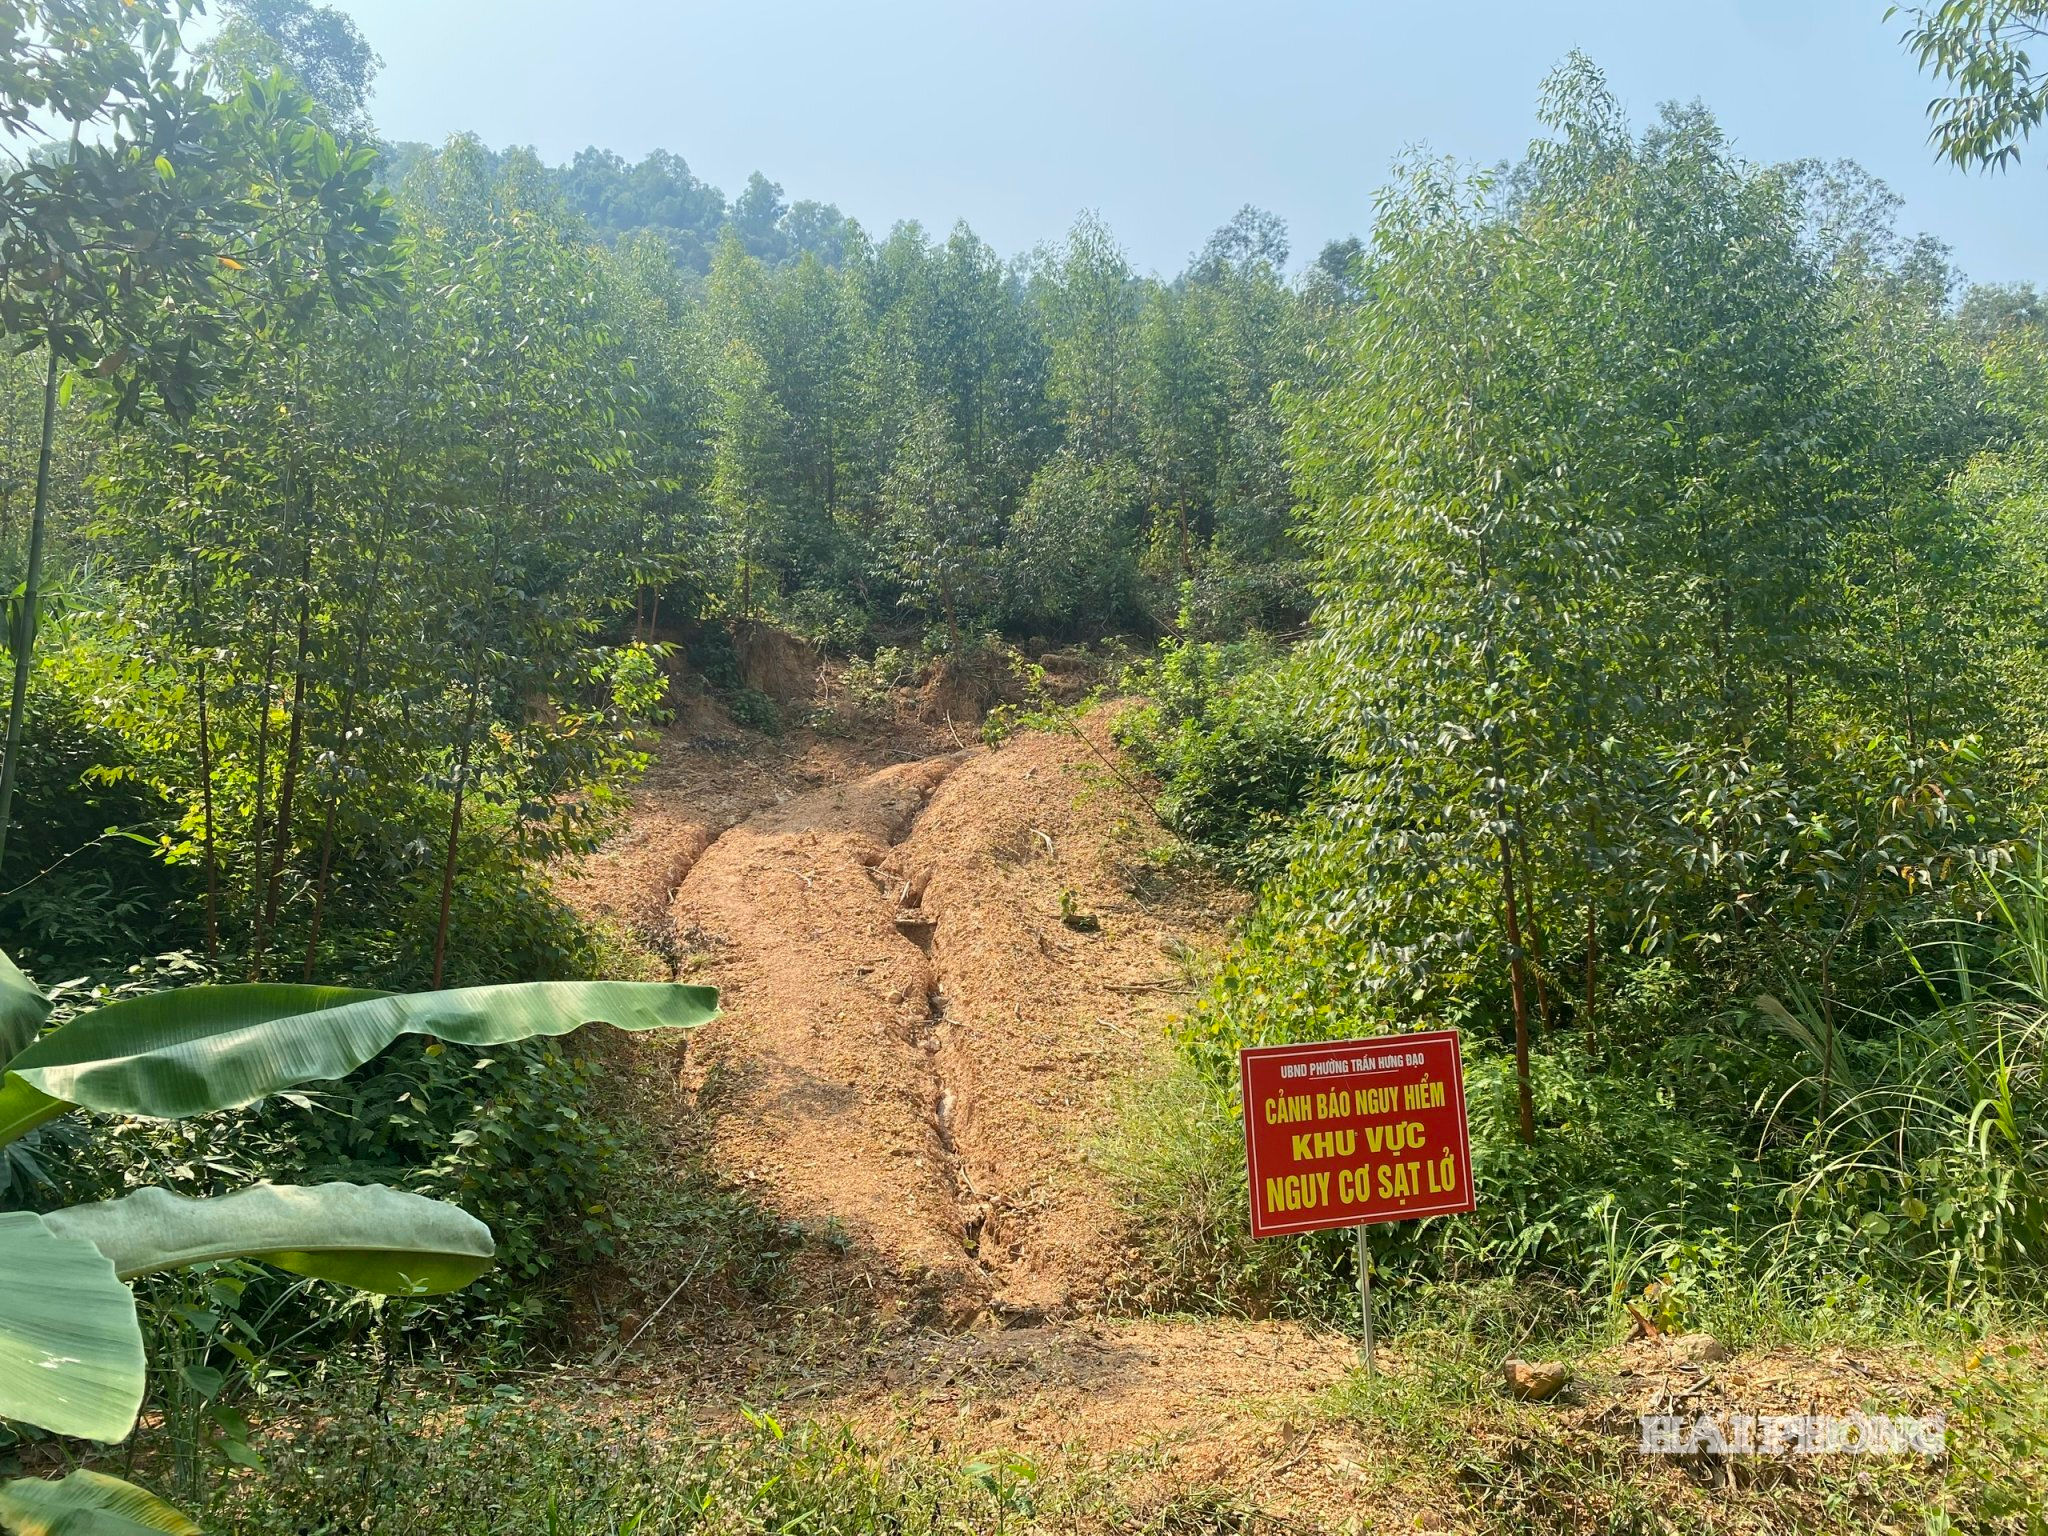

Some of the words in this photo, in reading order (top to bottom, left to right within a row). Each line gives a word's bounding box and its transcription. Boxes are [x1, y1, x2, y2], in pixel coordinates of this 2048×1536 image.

[1281, 1064, 1308, 1079] UBND
[1310, 1058, 1348, 1076] PHƯỜNG
[1378, 1055, 1403, 1069] HƯNG
[1406, 1053, 1425, 1069] ĐẠO
[1265, 1088, 1312, 1125] CẢNH
[1317, 1087, 1350, 1120] BÁO
[1355, 1086, 1399, 1115] NGUY
[1404, 1073, 1446, 1111] HIỂM
[1292, 1130, 1355, 1161] KHU
[1365, 1121, 1426, 1156] VỰC
[1266, 1172, 1330, 1213] NGUY
[1339, 1164, 1370, 1205] CƠ
[1378, 1161, 1420, 1205] SẠT
[1427, 1147, 1456, 1193] LỞ
